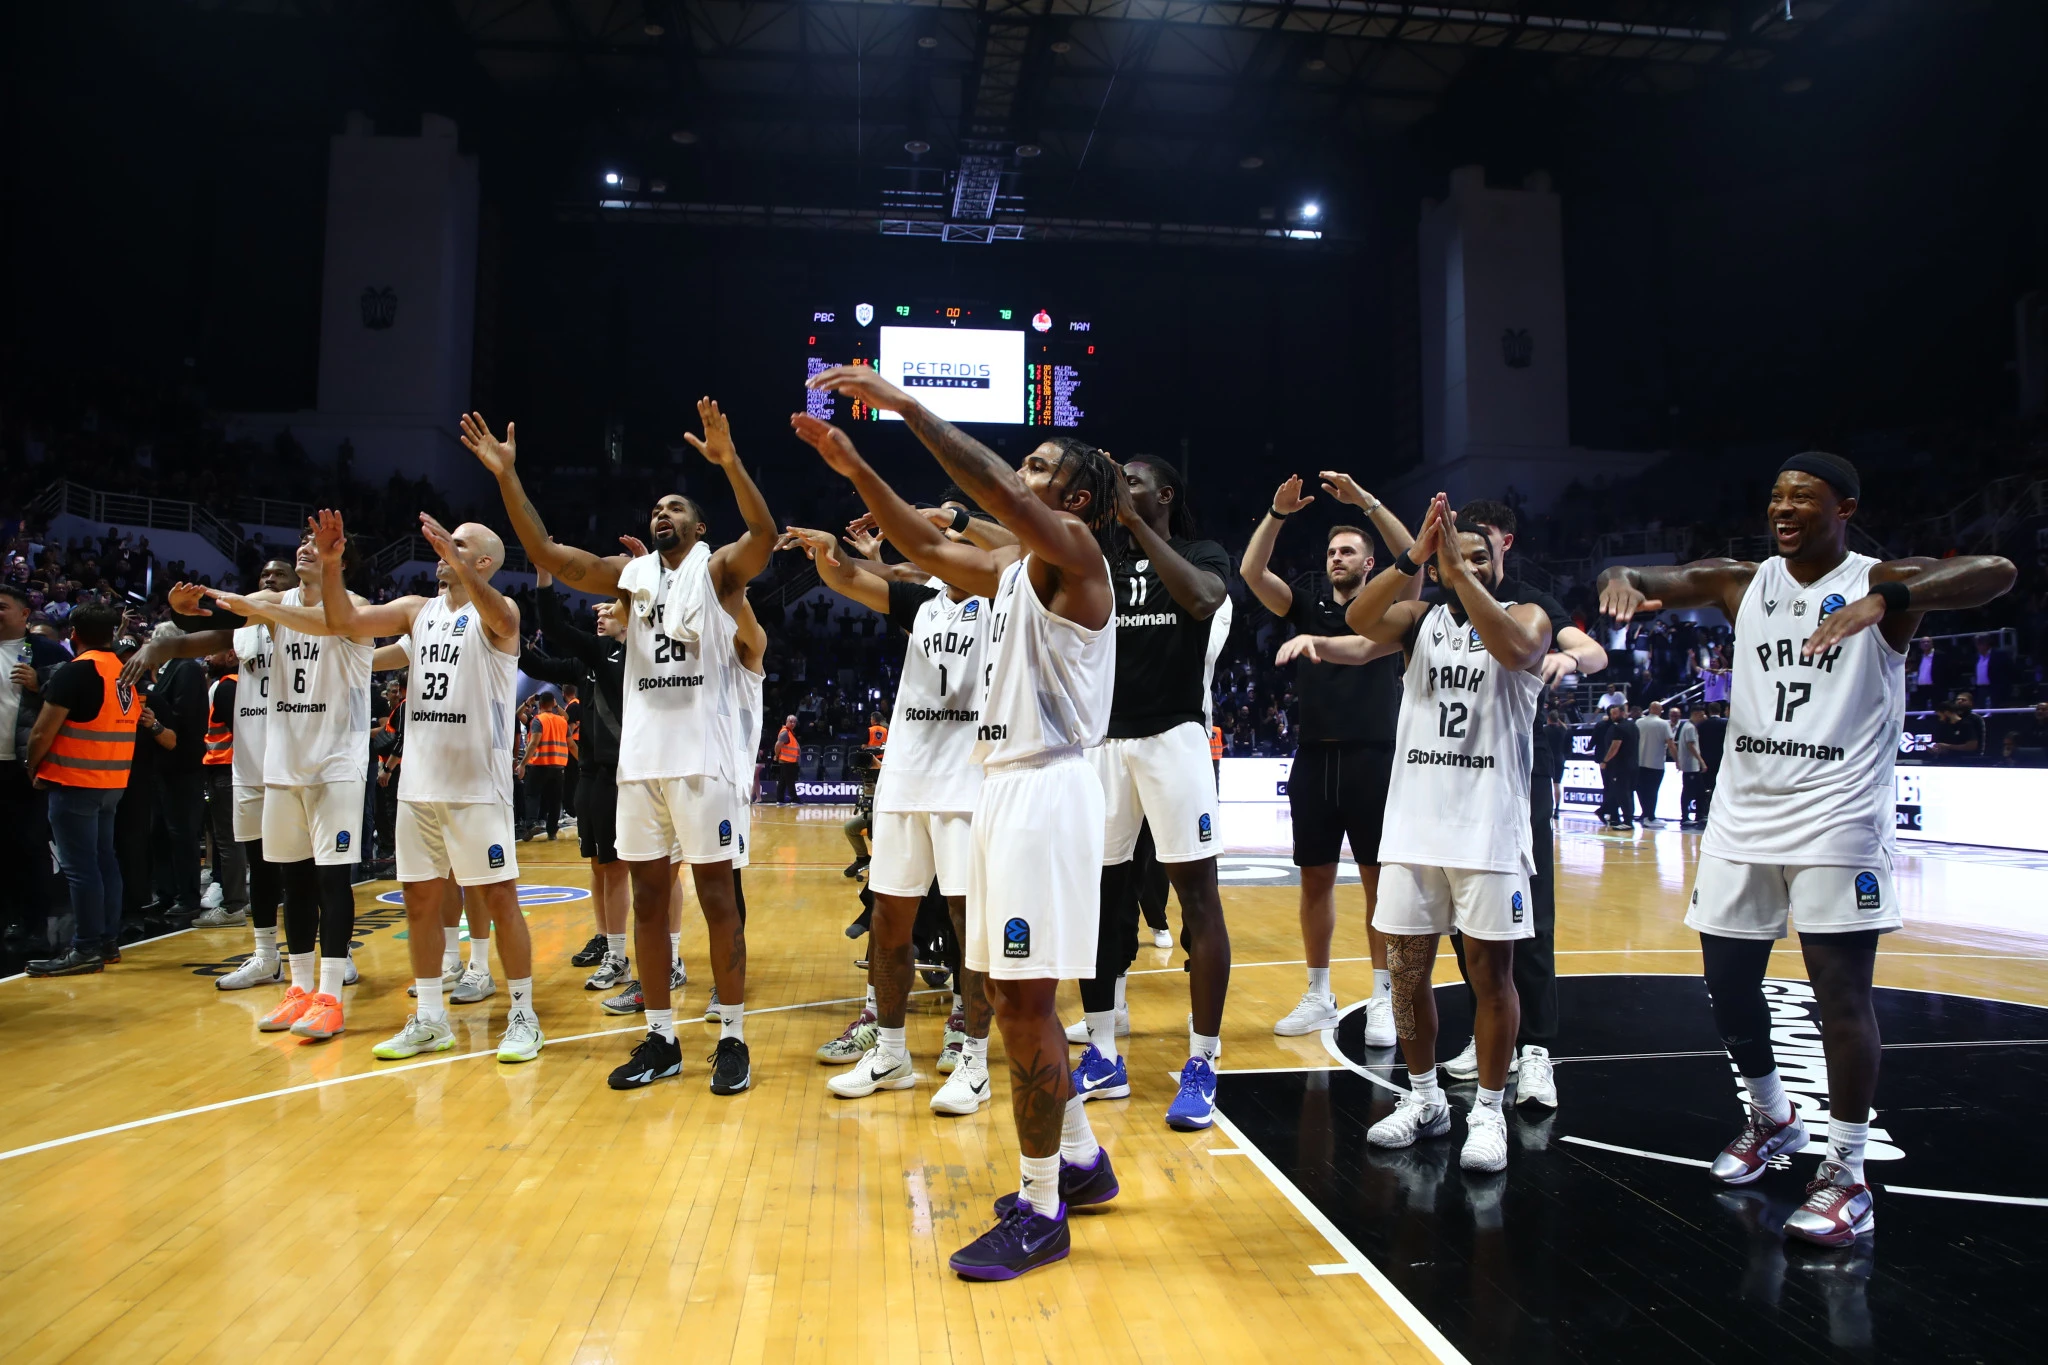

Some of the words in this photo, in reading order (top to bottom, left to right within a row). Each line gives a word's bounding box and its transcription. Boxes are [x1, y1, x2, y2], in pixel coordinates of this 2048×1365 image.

[814, 312, 835, 322] PBC
[896, 305, 910, 316] 93
[999, 309, 1012, 319] 78
[1069, 321, 1091, 331] MAN
[808, 336, 816, 345] 0
[1087, 345, 1095, 354] 0
[903, 361, 990, 377] PETRIDIS
[912, 378, 978, 387] LIGHTING
[1129, 576, 1147, 606] 11
[655, 633, 686, 664] 26
[923, 632, 974, 658] PAOK
[293, 668, 306, 694] 6
[422, 672, 449, 700] 33
[938, 663, 948, 696] 1
[1428, 664, 1486, 694] PAOK
[1774, 681, 1812, 723] 17
[905, 707, 979, 722] Stoiximan
[1438, 701, 1469, 739] 12
[1406, 748, 1495, 769] Stoiximan
[1734, 735, 1846, 762] Stoiximan
